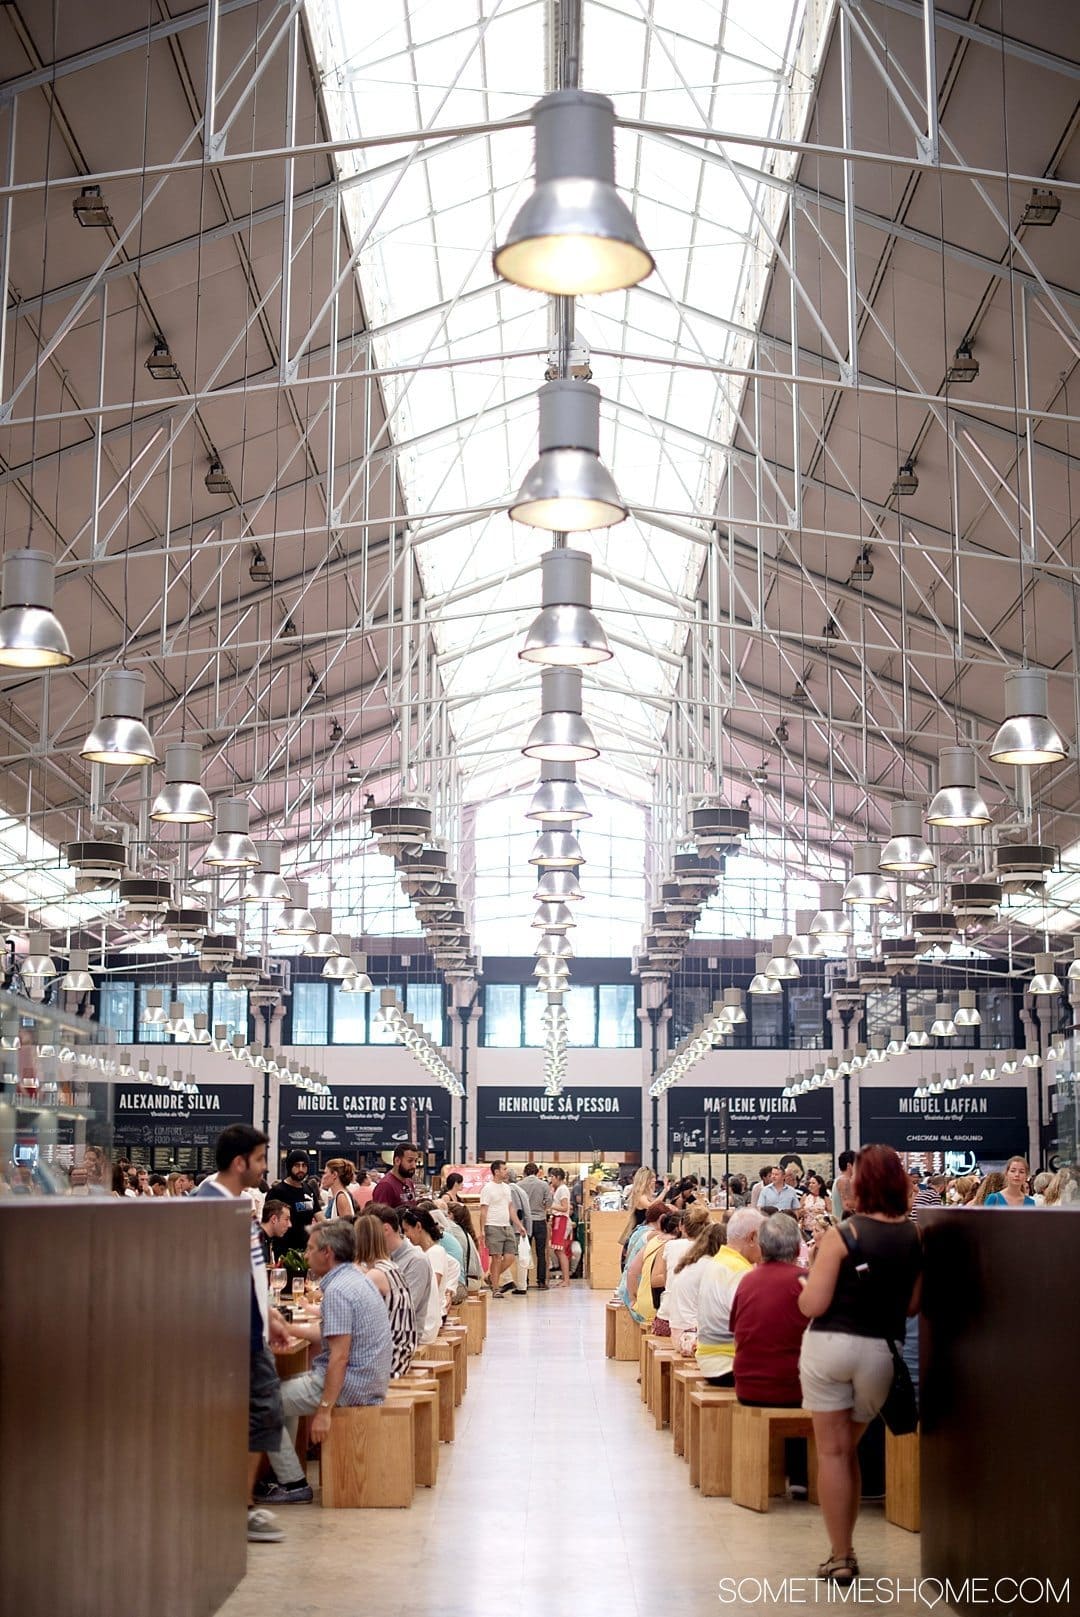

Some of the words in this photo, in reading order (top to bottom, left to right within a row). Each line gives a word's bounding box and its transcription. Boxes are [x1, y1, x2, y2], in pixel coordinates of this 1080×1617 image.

[119, 1094, 184, 1109] ALEXANDRE
[187, 1095, 220, 1110] SILVA
[297, 1095, 339, 1111] MIGUEL
[343, 1096, 386, 1111] CASTRO
[390, 1097, 396, 1111] E
[498, 1097, 554, 1112] HENRIQUE
[558, 1095, 573, 1112] SÁ
[576, 1098, 620, 1112] PESSOA
[759, 1098, 797, 1112] VIEIRA
[899, 1098, 940, 1113] MIGUEL
[944, 1098, 988, 1113] LAFFAN
[154, 1136, 170, 1144] FOOD
